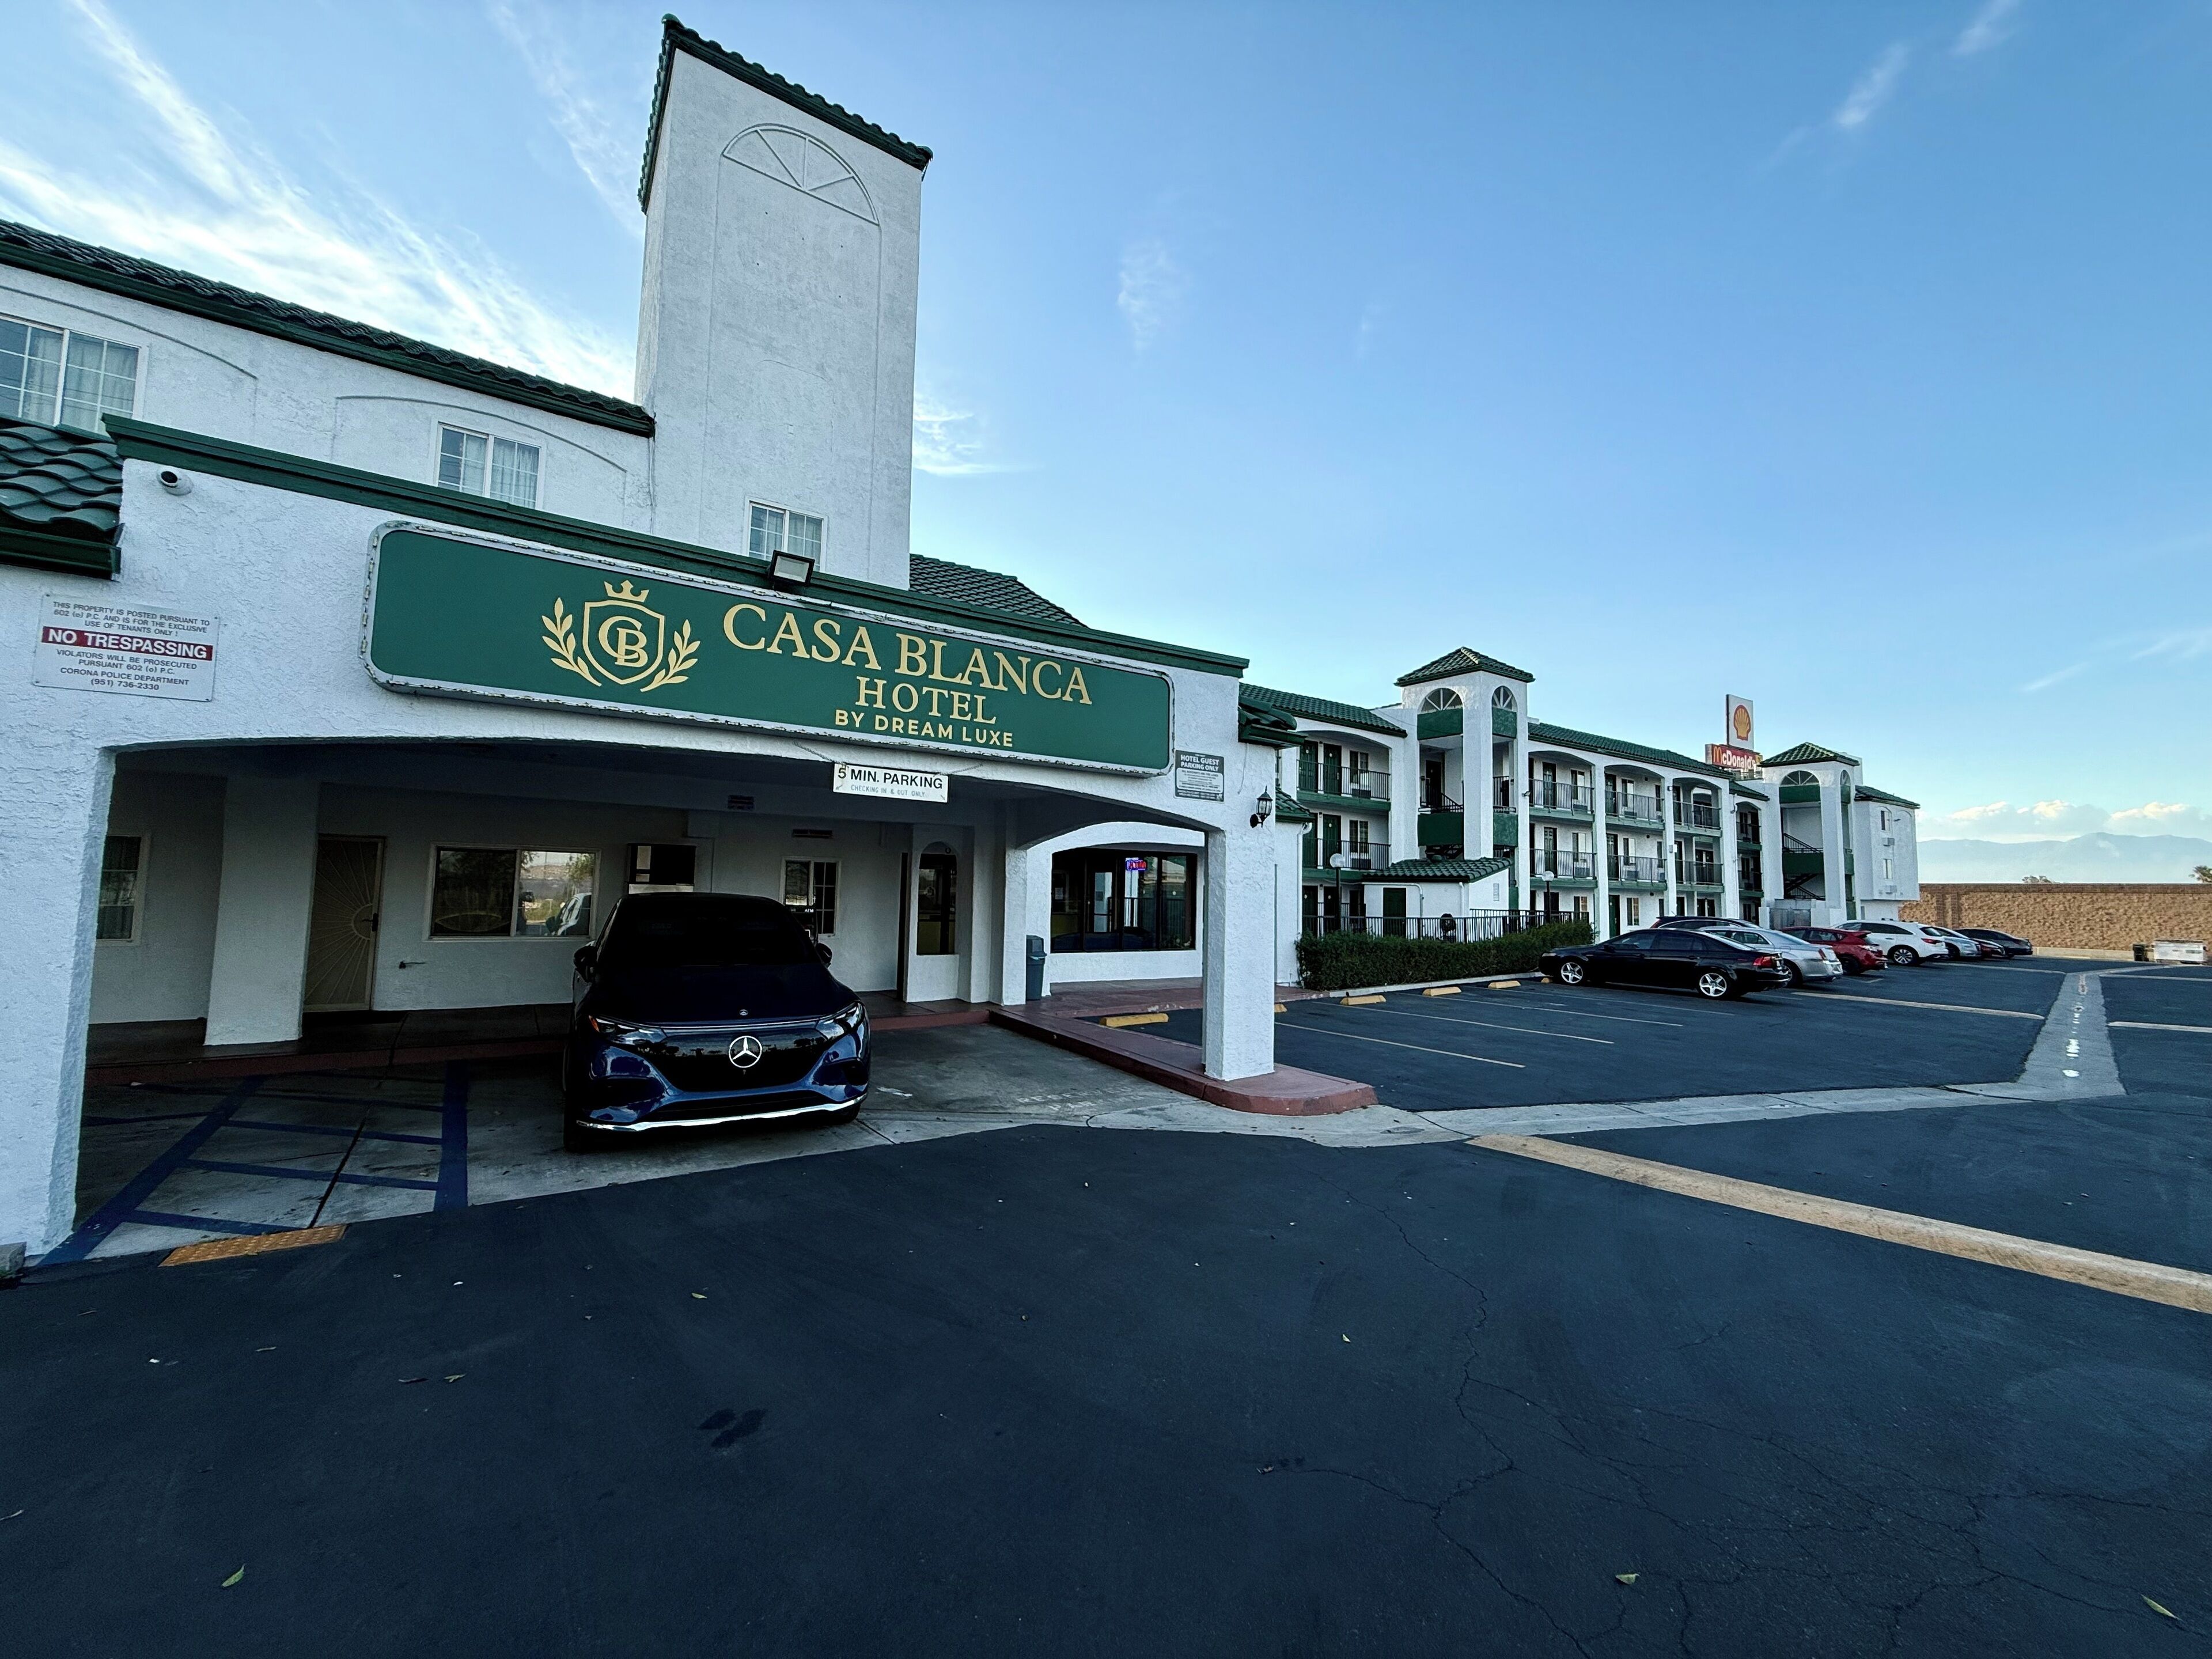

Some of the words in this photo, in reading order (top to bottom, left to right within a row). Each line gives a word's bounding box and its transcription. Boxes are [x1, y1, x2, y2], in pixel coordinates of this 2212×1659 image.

[74, 604, 114, 613] PROPERTY
[127, 611, 157, 619] POSTED
[160, 614, 198, 624] PURSUANT
[117, 624, 151, 633] TENANTS
[168, 623, 207, 633] EXCLUSIVE
[48, 628, 77, 644] NO
[84, 632, 207, 658] TRESPASSING
[56, 649, 104, 660] VIOLATORS
[143, 658, 197, 669] PROSECUTED
[724, 604, 881, 670] CASA
[895, 633, 1092, 704] BLANCA
[78, 659, 123, 669] PURSUANT
[60, 667, 99, 676] CORONA
[101, 671, 132, 680] POLICE
[134, 675, 189, 685] DEPARTMENT
[91, 679, 113, 687] (951)
[118, 681, 159, 691] 736-2330
[855, 676, 997, 724] HOTEL
[835, 709, 865, 728] BY
[875, 715, 953, 740] DREAM
[962, 726, 1013, 747] LUXE
[1180, 755, 1199, 763] HOTEL
[1200, 757, 1219, 766] GUEST
[1180, 762, 1204, 770] PARKING
[1713, 747, 1757, 768] McDonald's
[838, 767, 847, 779] 5
[851, 768, 880, 782] MIN.
[883, 772, 942, 789] PARKING
[851, 785, 879, 793] CHECKING
